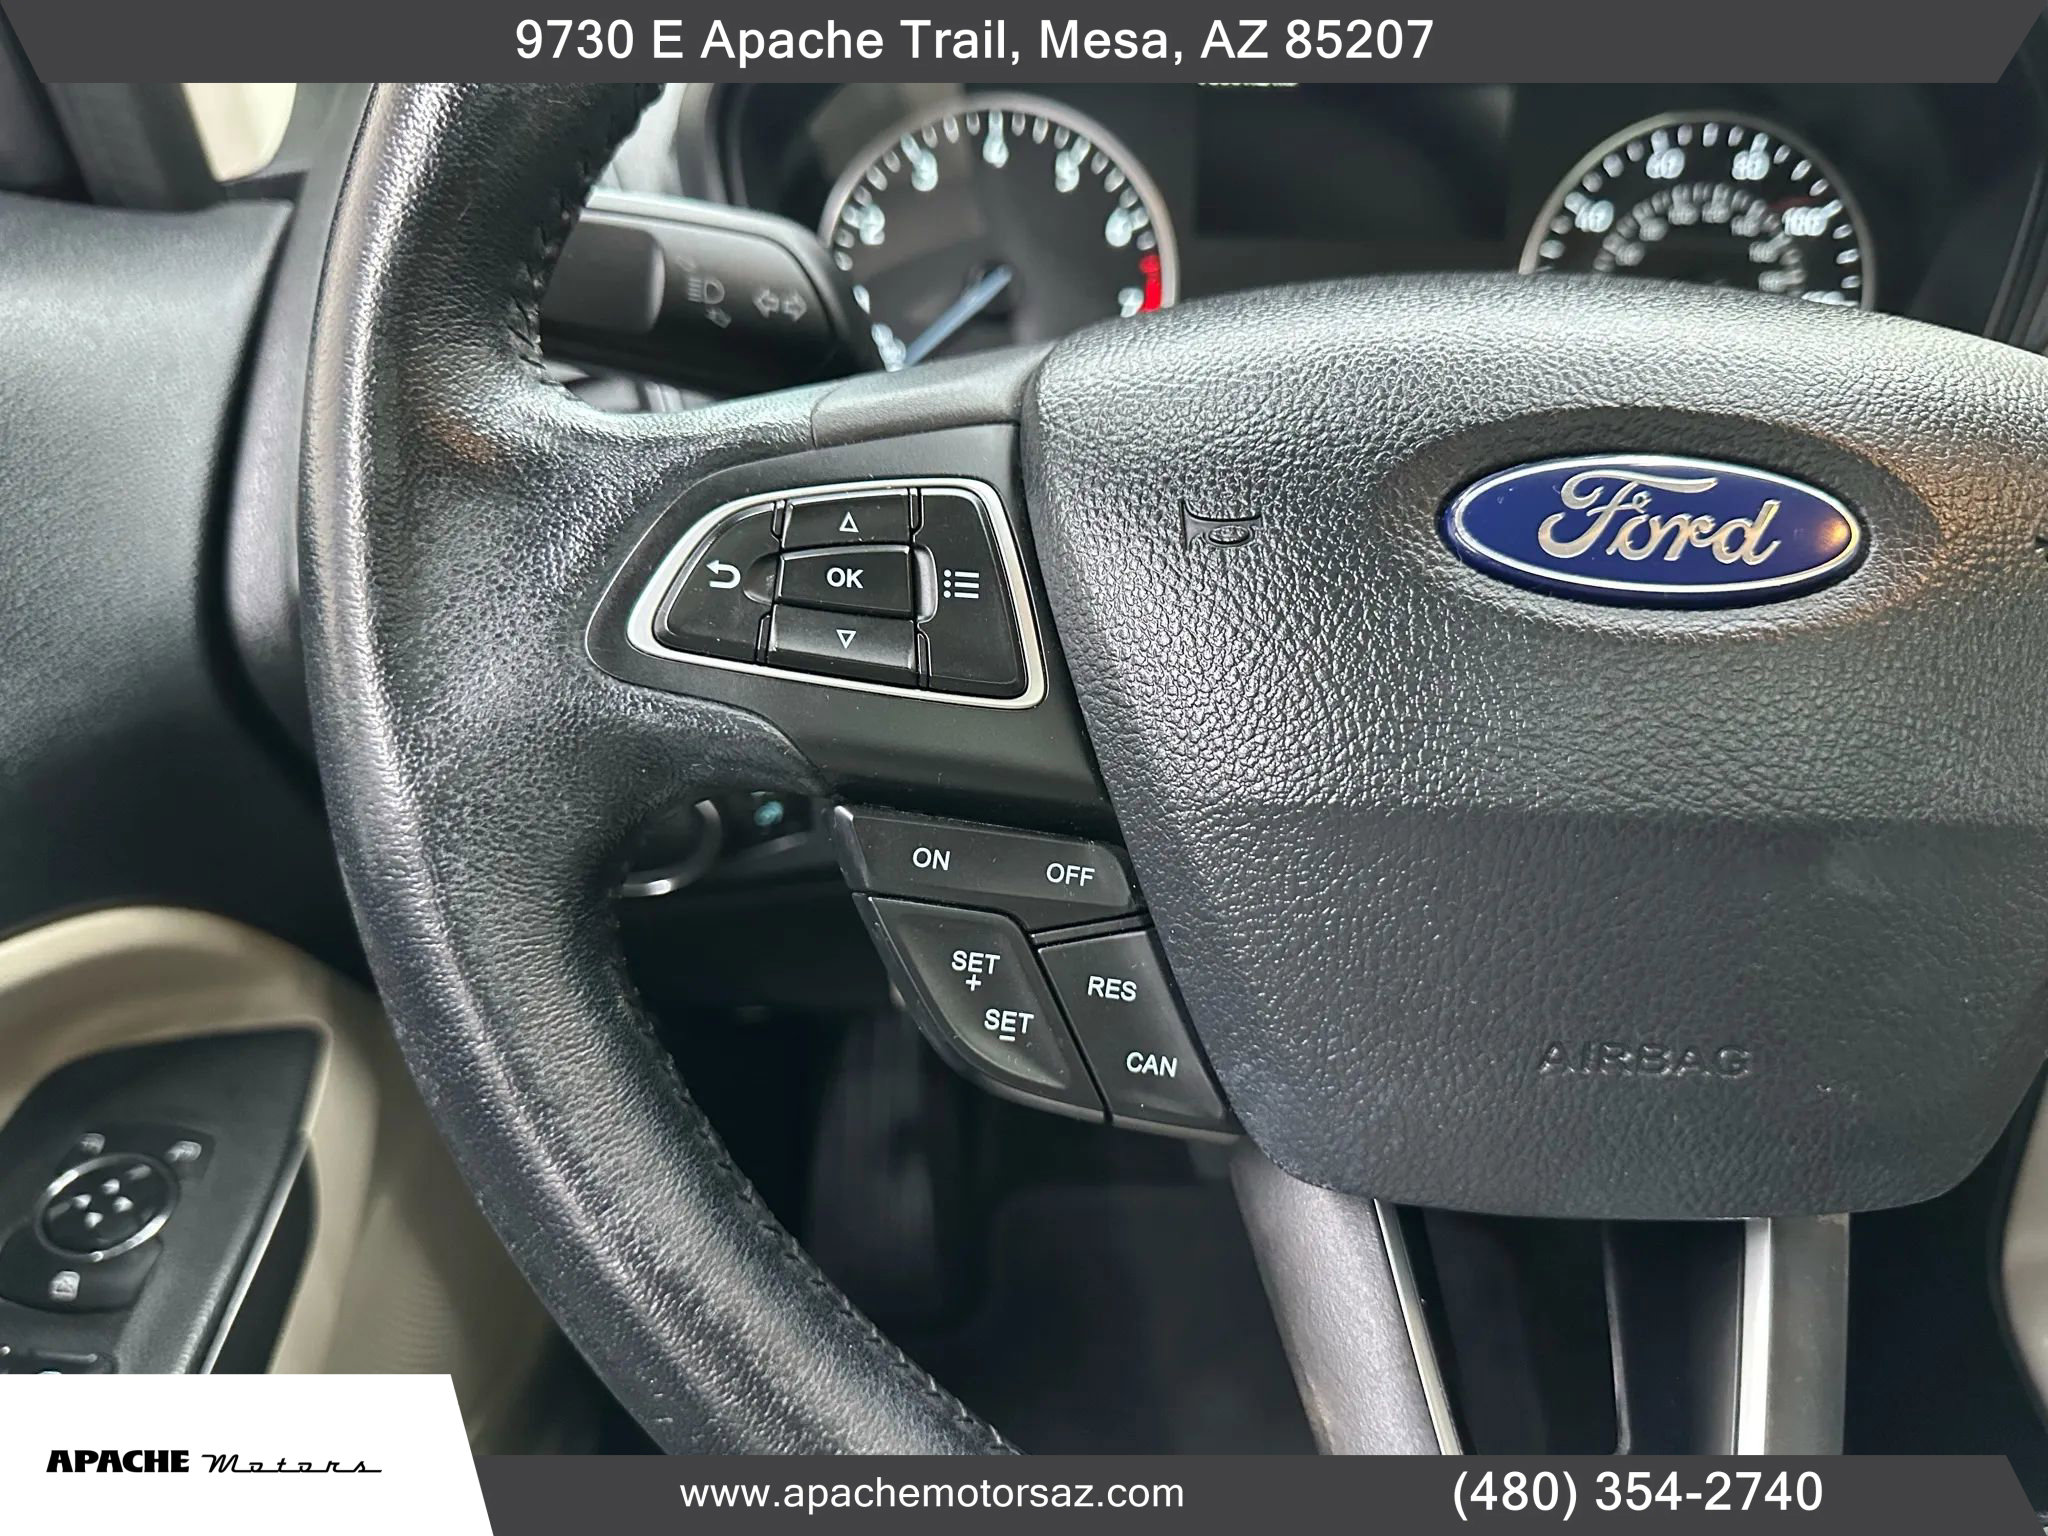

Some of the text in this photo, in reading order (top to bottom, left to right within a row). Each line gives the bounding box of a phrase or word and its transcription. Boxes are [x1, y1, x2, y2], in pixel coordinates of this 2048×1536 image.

[1537, 468, 1782, 566] Ford
[826, 567, 864, 590] OK
[912, 846, 952, 871] ON
[1045, 862, 1096, 888] OFF
[951, 950, 1001, 975] SET
[1087, 975, 1138, 1002] RES
[983, 1008, 1035, 1034] SET
[1126, 1050, 1178, 1078] CAN
[1538, 1041, 1751, 1079] AIRBAG
